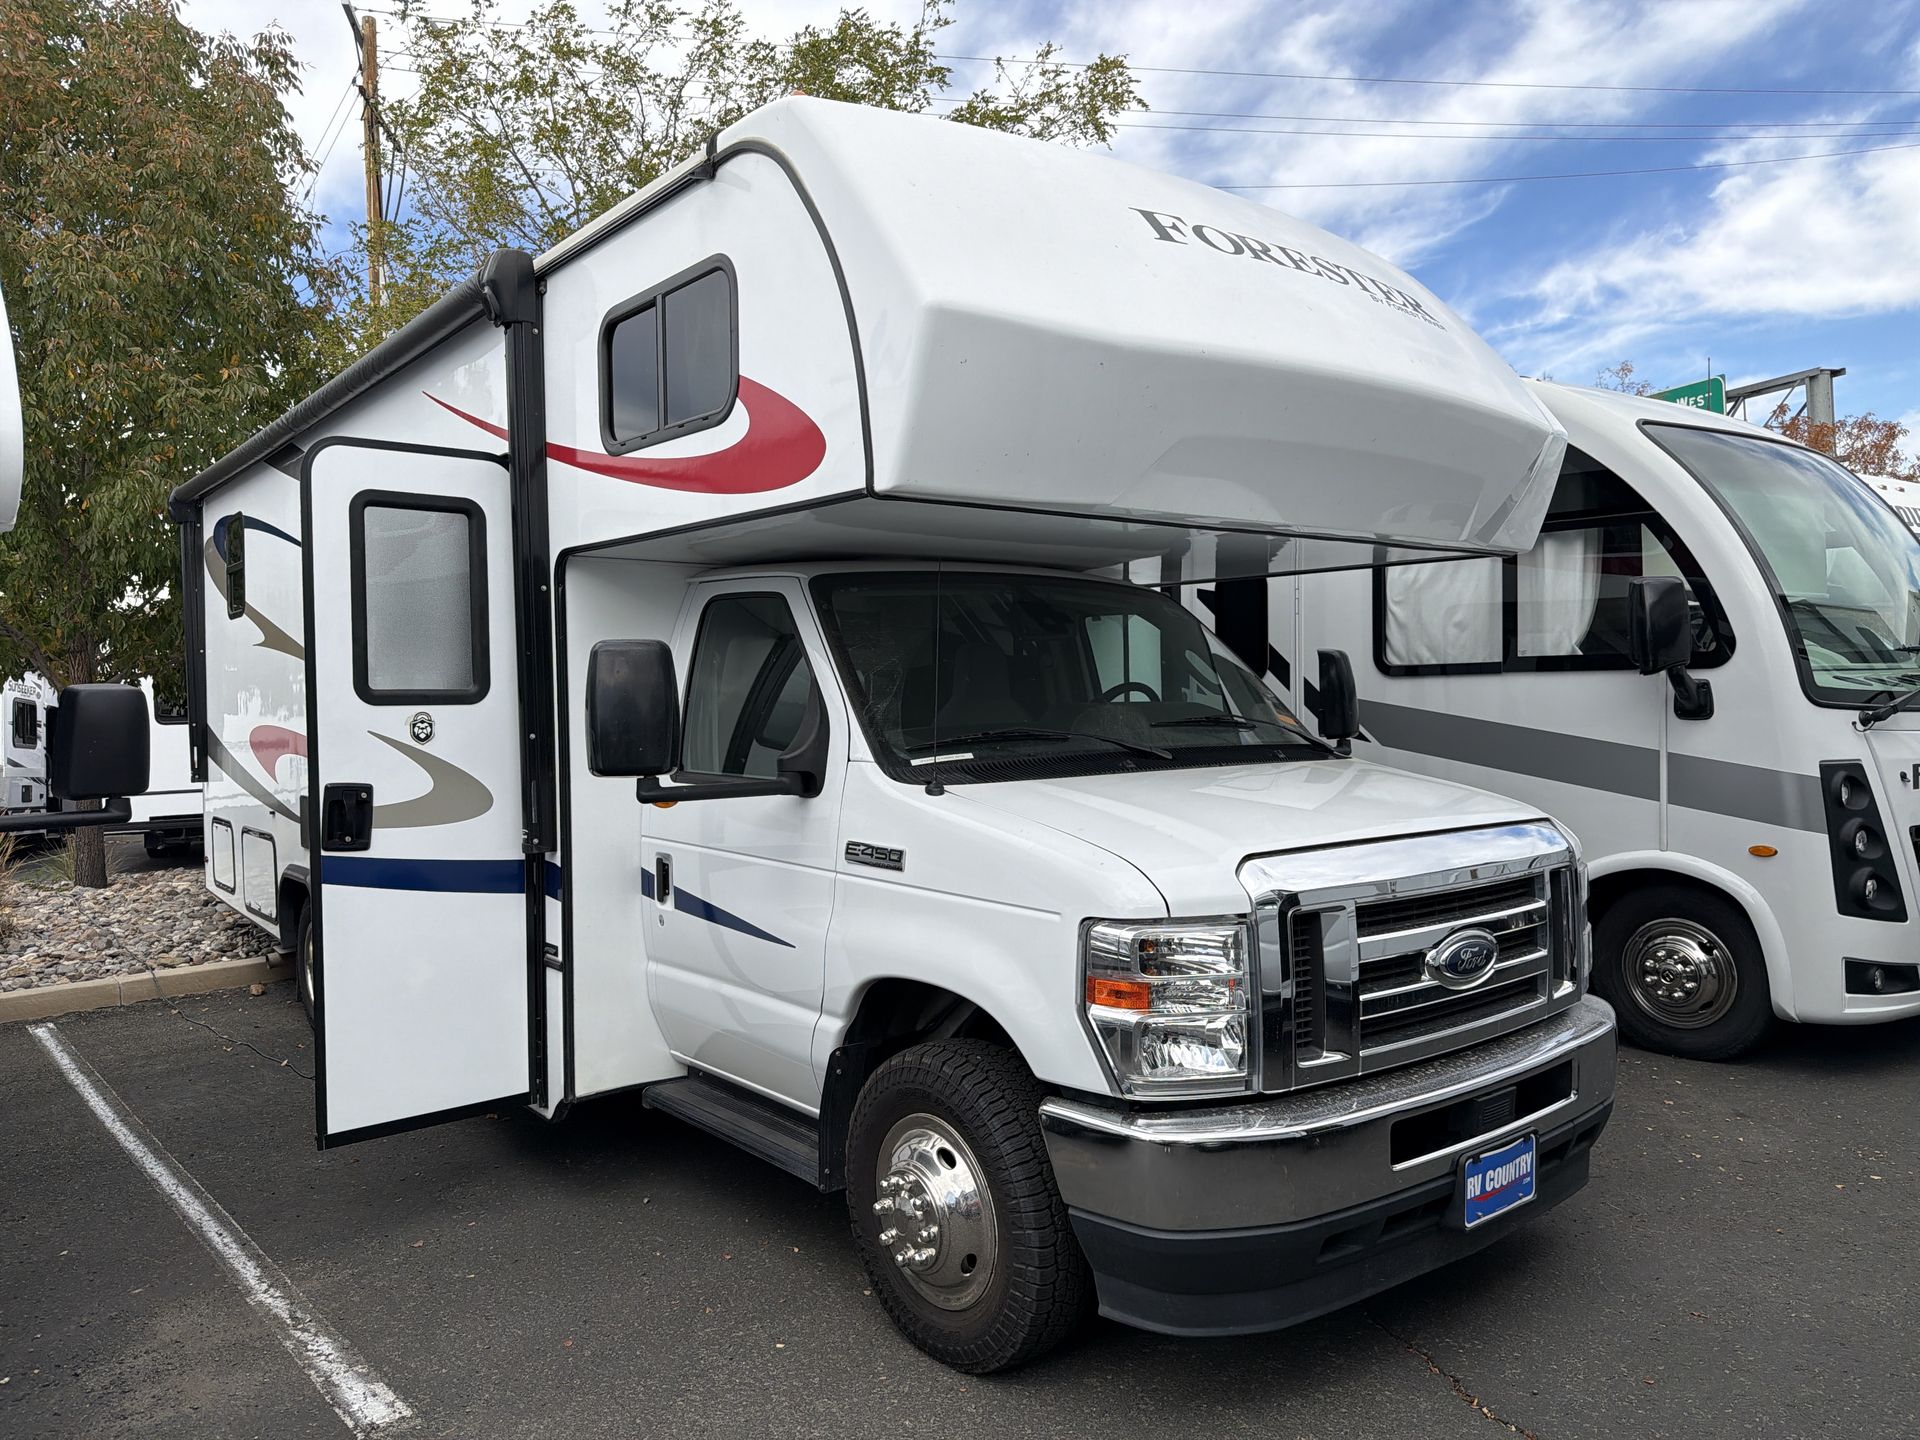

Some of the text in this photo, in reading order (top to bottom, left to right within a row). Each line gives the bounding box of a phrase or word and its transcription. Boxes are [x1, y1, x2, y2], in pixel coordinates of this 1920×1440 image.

[1128, 207, 1440, 323] FORESTER
[1458, 947, 1487, 971] Ford
[1467, 1151, 1532, 1199] RV COUNTRY
